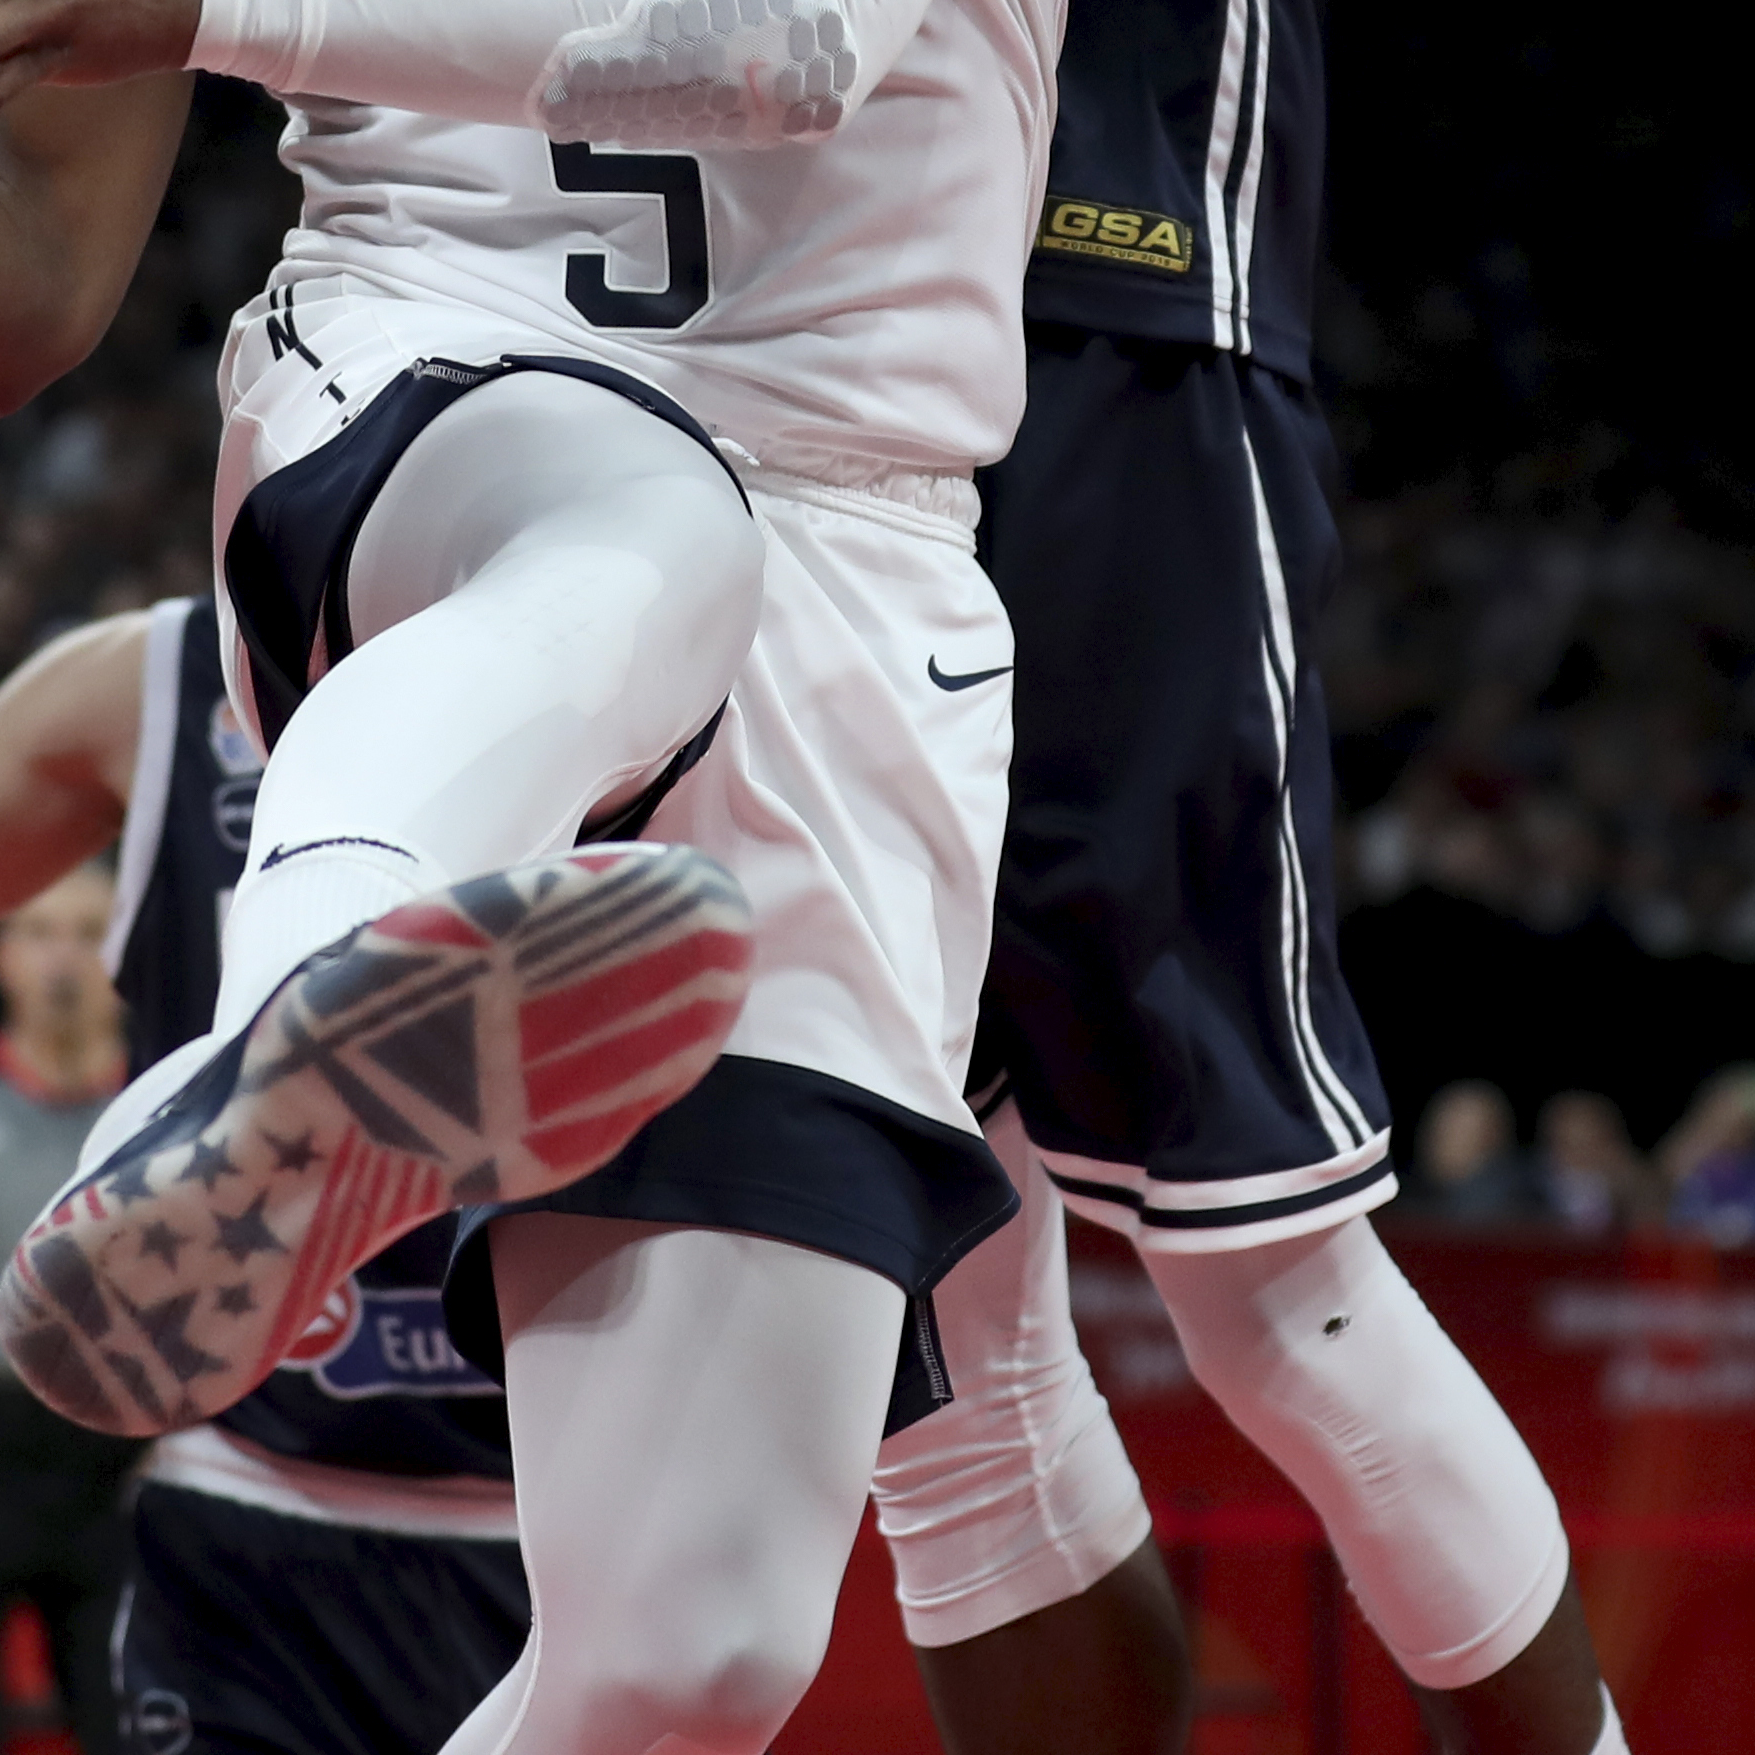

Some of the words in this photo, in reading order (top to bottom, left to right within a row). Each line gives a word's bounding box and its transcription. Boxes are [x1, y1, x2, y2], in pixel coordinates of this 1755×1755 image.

[547, 137, 712, 331] 5
[1050, 201, 1182, 257] GSA
[1109, 247, 1135, 260] CUP
[376, 1314, 467, 1373] Eu
